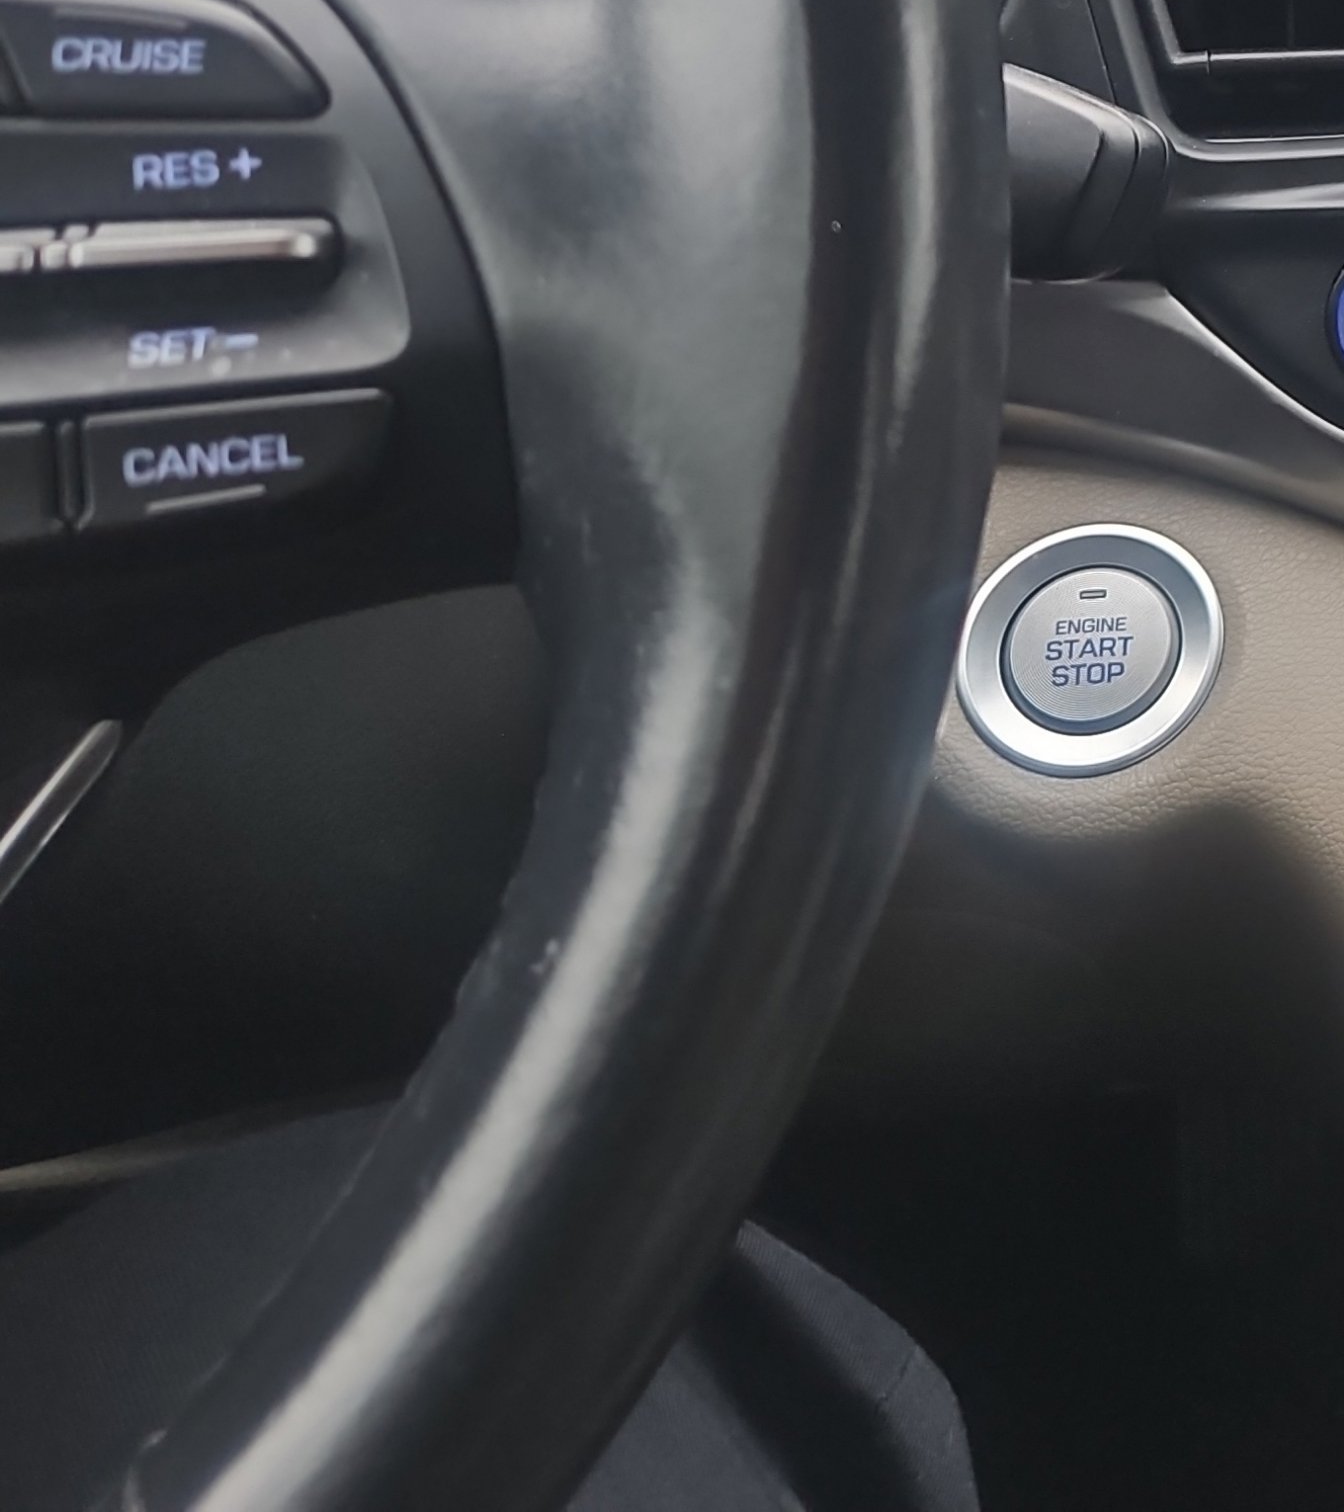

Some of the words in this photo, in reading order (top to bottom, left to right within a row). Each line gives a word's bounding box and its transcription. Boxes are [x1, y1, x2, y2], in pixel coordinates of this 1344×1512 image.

[51, 37, 204, 73] CRUISE
[121, 433, 304, 487] CANCEL
[1055, 616, 1128, 636] ENGINE
[1045, 636, 1134, 661] START
[1051, 662, 1126, 687] STOP
